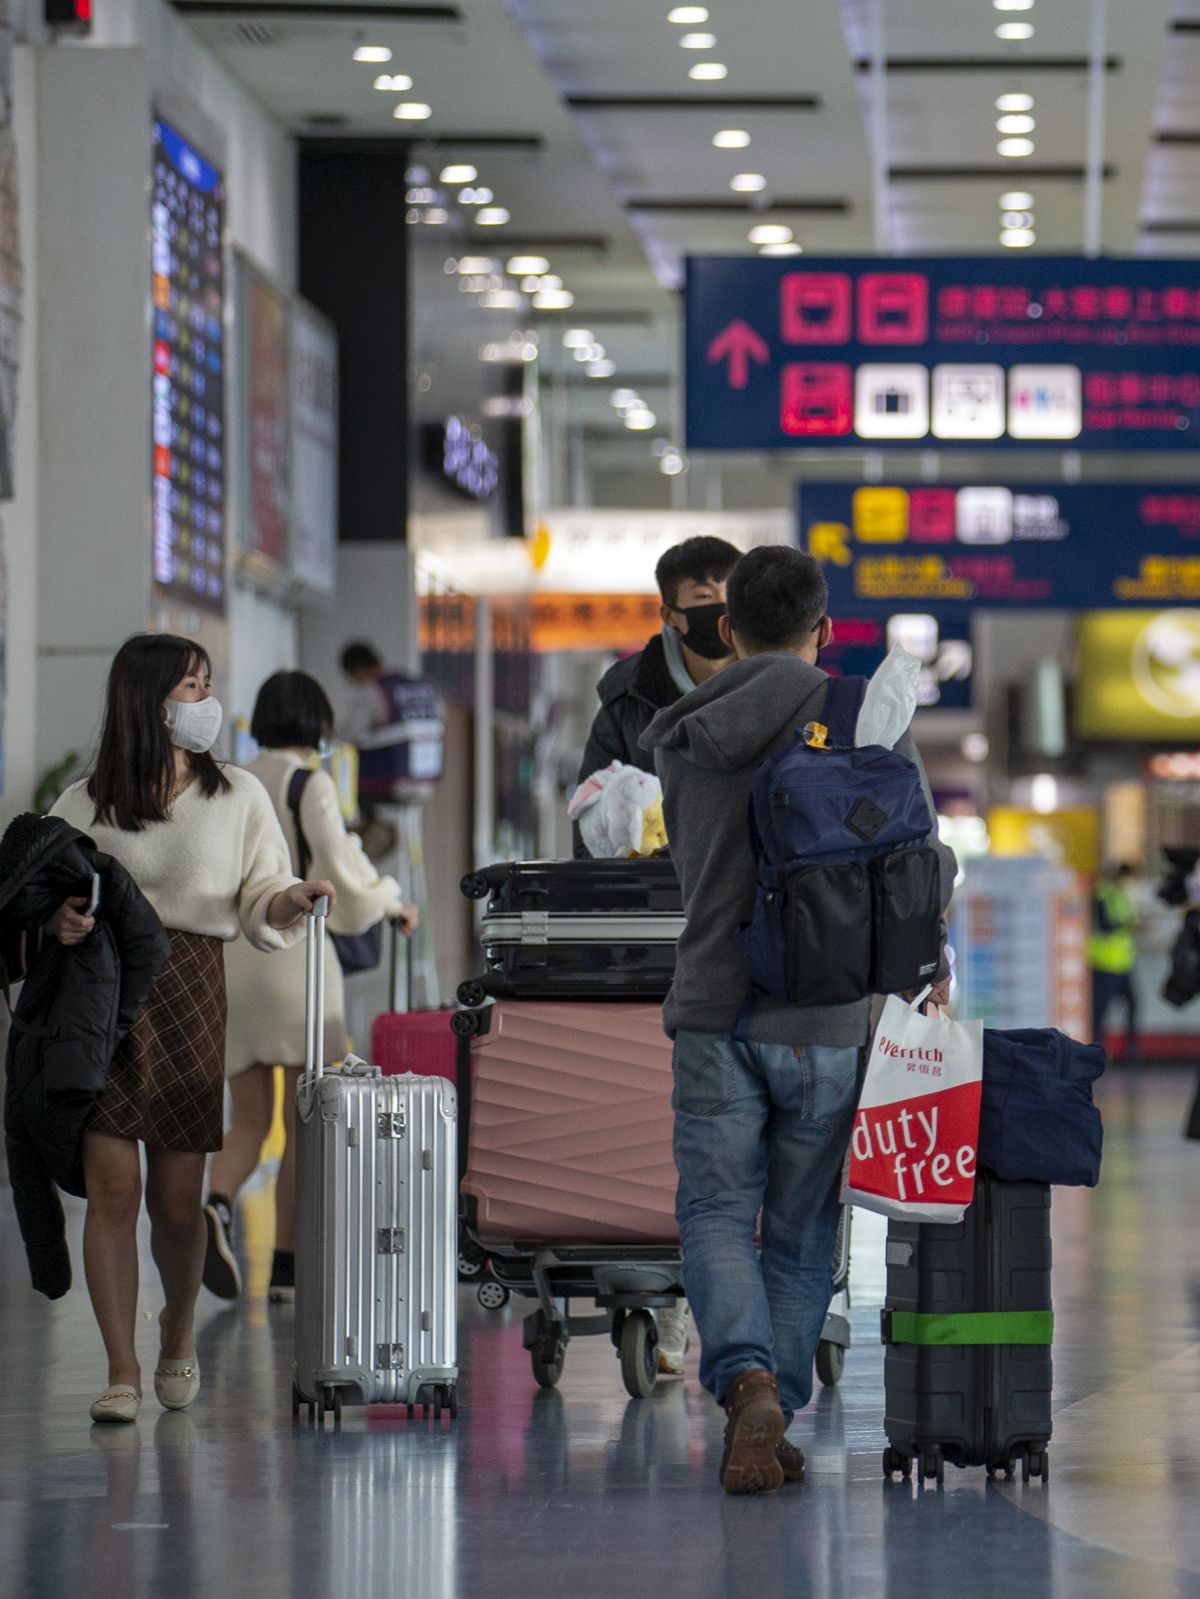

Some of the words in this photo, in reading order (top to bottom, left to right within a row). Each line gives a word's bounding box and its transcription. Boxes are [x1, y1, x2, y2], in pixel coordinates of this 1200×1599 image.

[878, 1036, 943, 1062] everrich
[851, 1106, 938, 1161] duty
[893, 1144, 976, 1200] free
